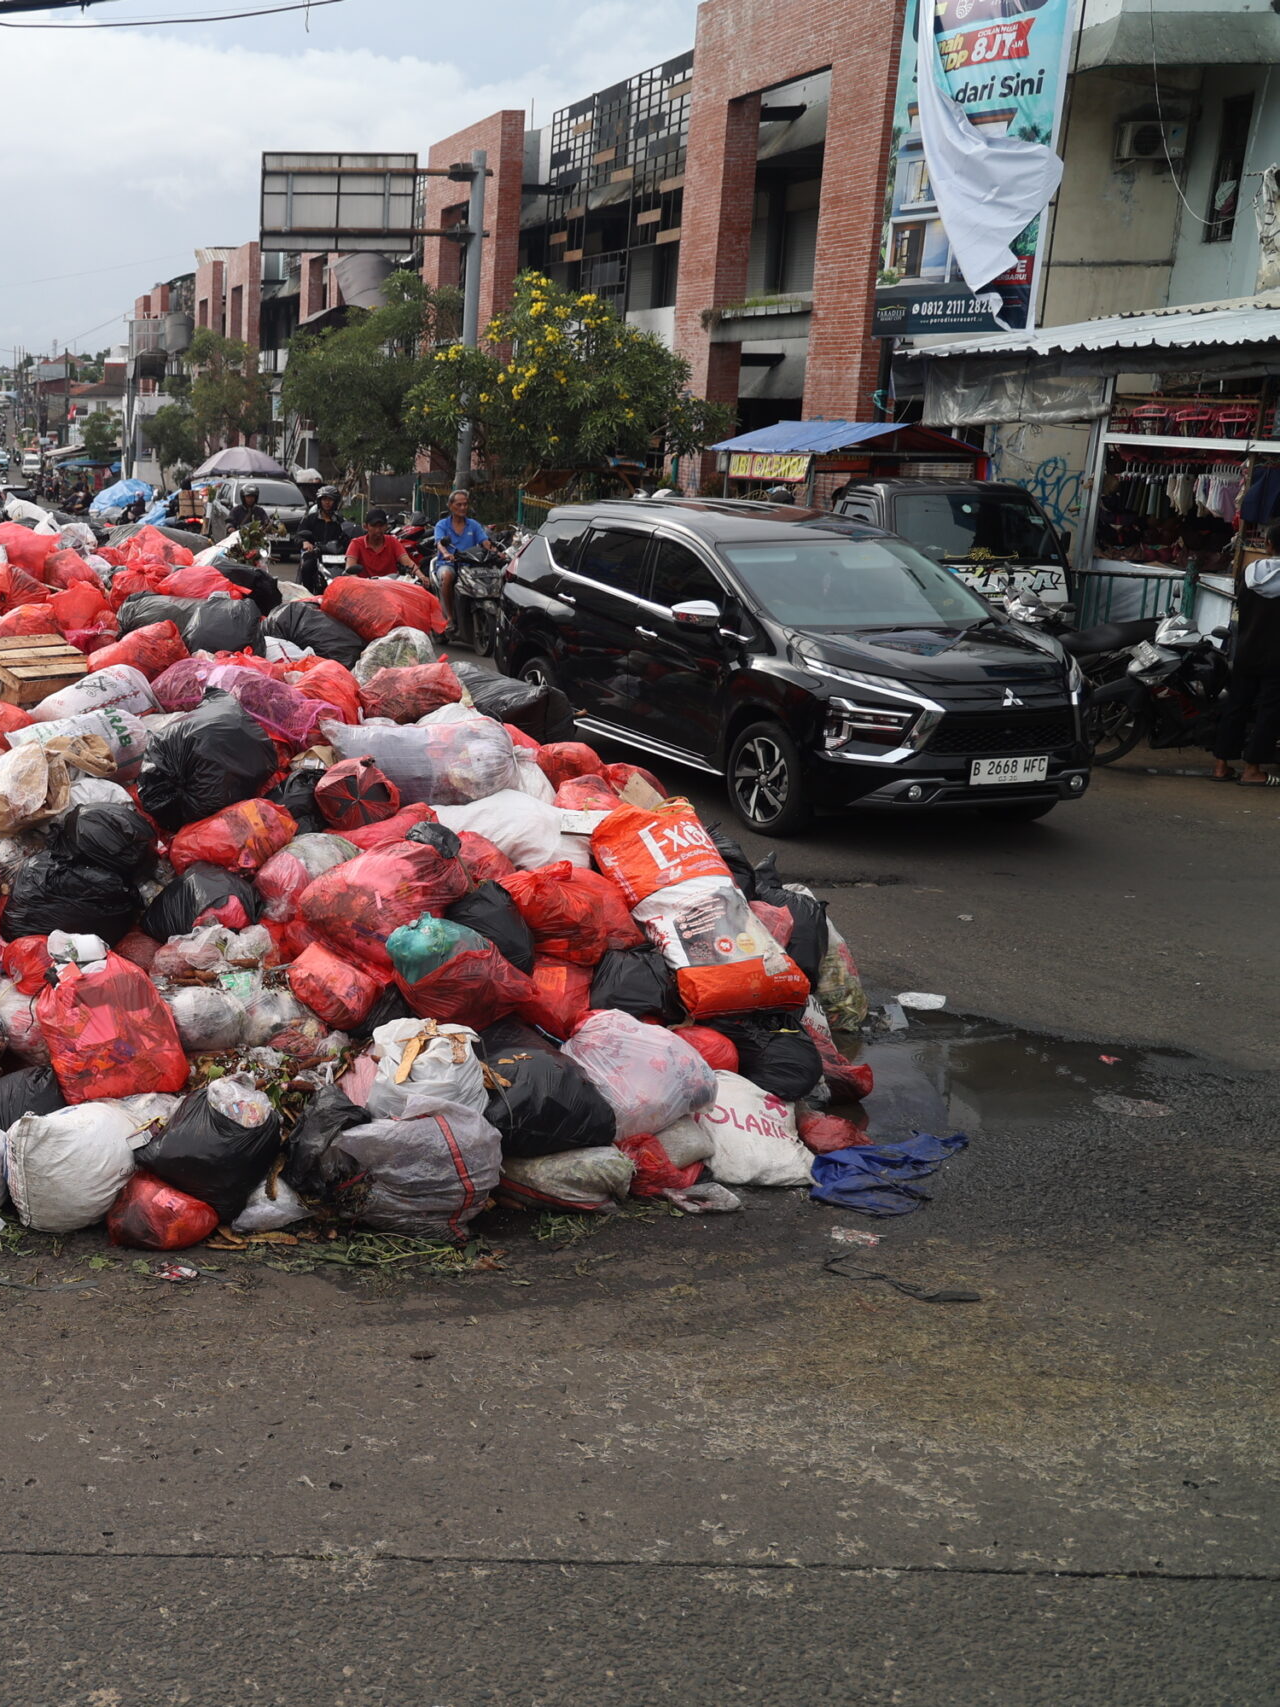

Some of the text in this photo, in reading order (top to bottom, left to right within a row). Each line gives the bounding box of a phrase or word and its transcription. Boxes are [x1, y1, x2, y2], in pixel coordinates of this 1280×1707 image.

[955, 69, 1046, 104] dari Sini
[920, 301, 943, 316] 0812
[946, 299, 966, 314] 2111
[729, 454, 752, 476] UBI
[973, 757, 1047, 777] B 2668 WFC
[694, 1104, 795, 1142] OLARIA
